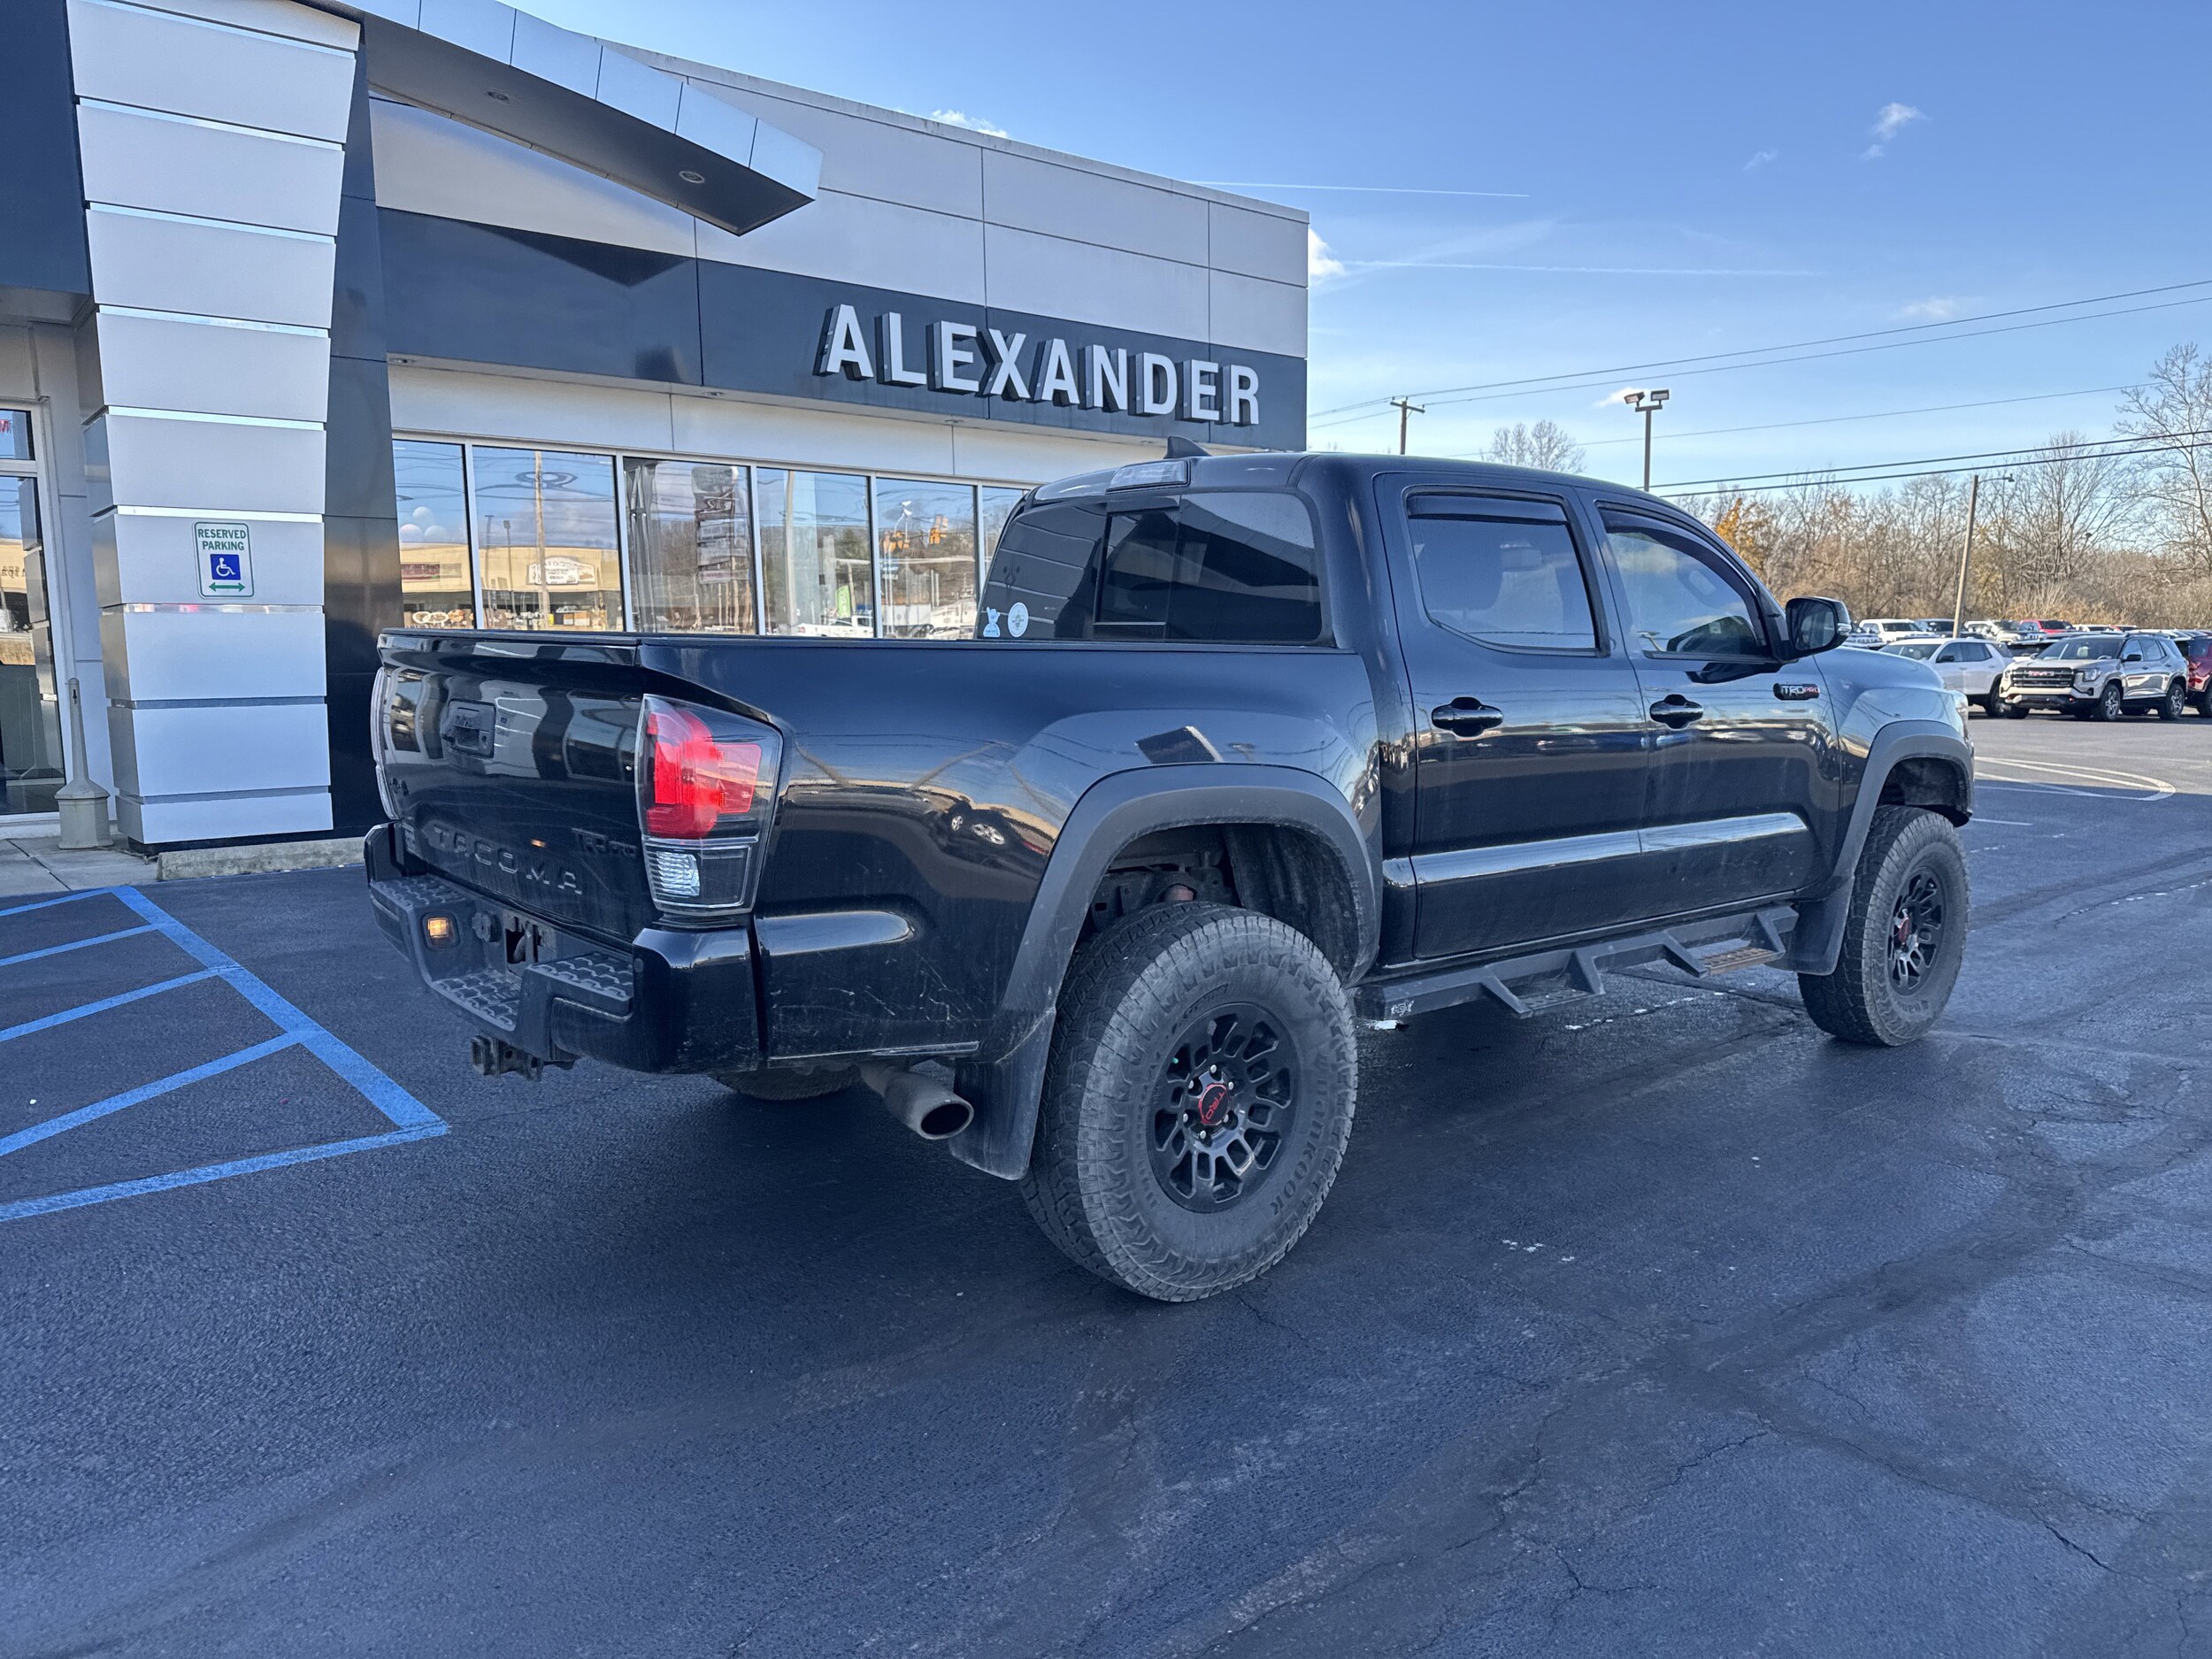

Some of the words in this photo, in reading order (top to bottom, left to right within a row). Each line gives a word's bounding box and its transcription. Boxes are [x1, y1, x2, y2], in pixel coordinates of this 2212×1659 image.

[819, 303, 1260, 426] ALEXANDER
[197, 528, 247, 539] RESERVED
[202, 541, 245, 551] PARKING
[1781, 686, 1804, 695] TRD
[433, 824, 583, 895] TACOMA
[1205, 1091, 1225, 1119] TRD
